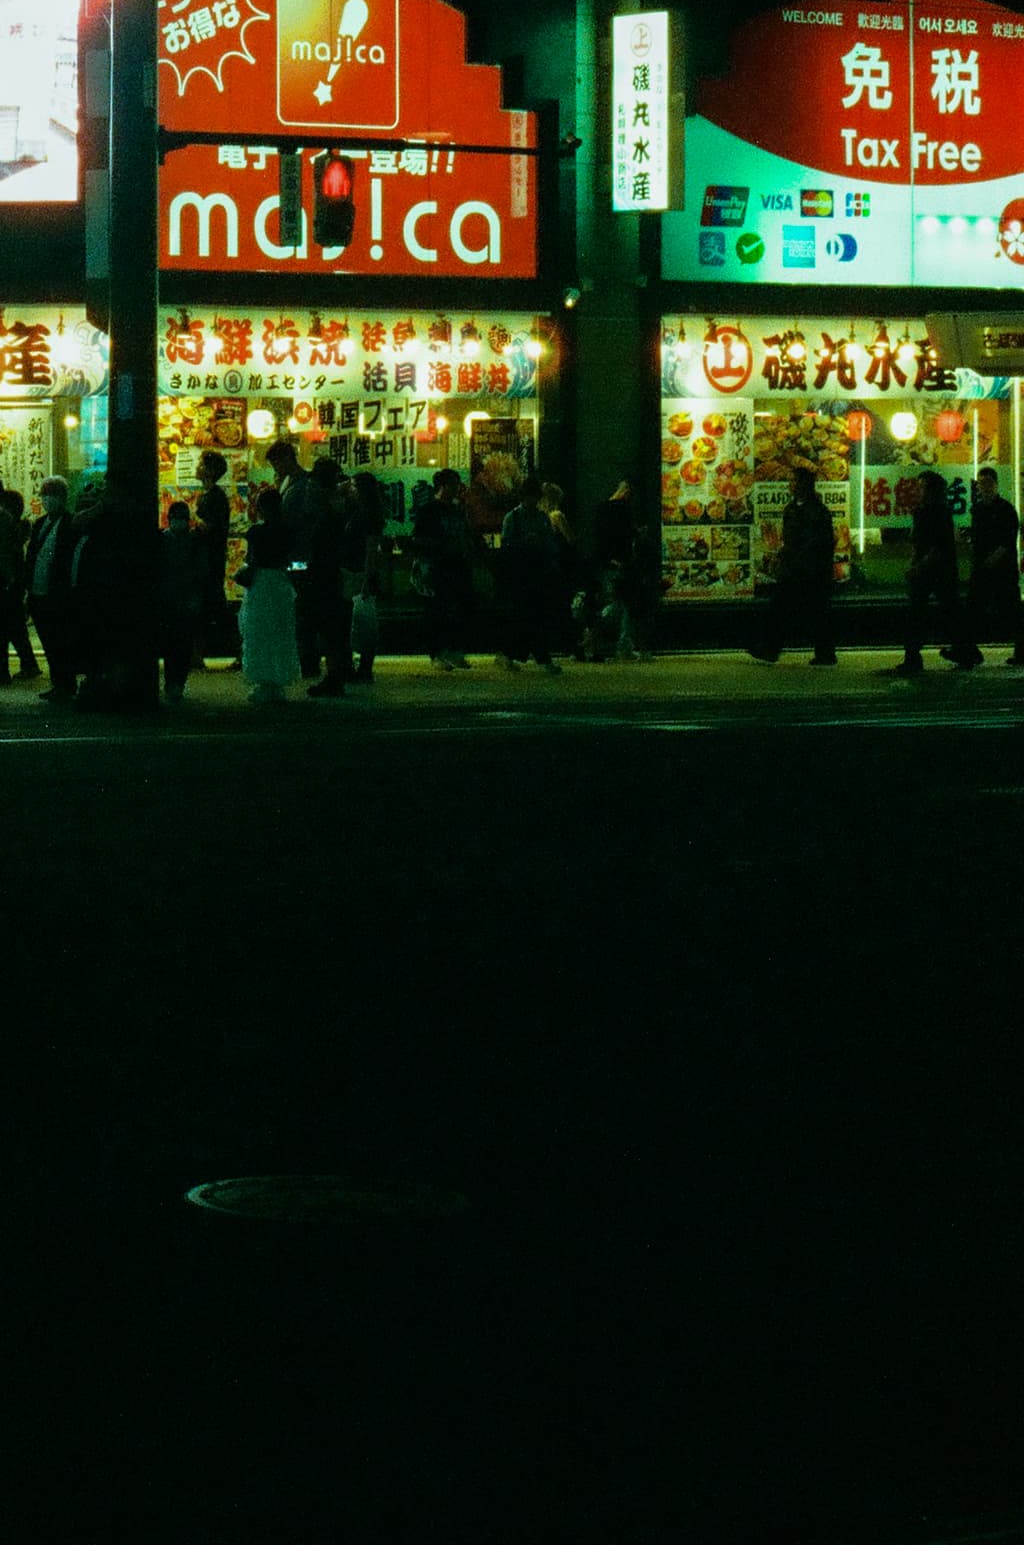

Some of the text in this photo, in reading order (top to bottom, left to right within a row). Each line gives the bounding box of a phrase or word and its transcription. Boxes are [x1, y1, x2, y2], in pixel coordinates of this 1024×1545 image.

[782, 10, 843, 26] WELCOME
[919, 17, 978, 35] 어서 오세요
[841, 42, 982, 116] 免税
[632, 64, 651, 201] 磯丸水産
[841, 128, 982, 172] Tax Free
[761, 194, 793, 211] VISA
[318, 399, 428, 430] 韓国フェア
